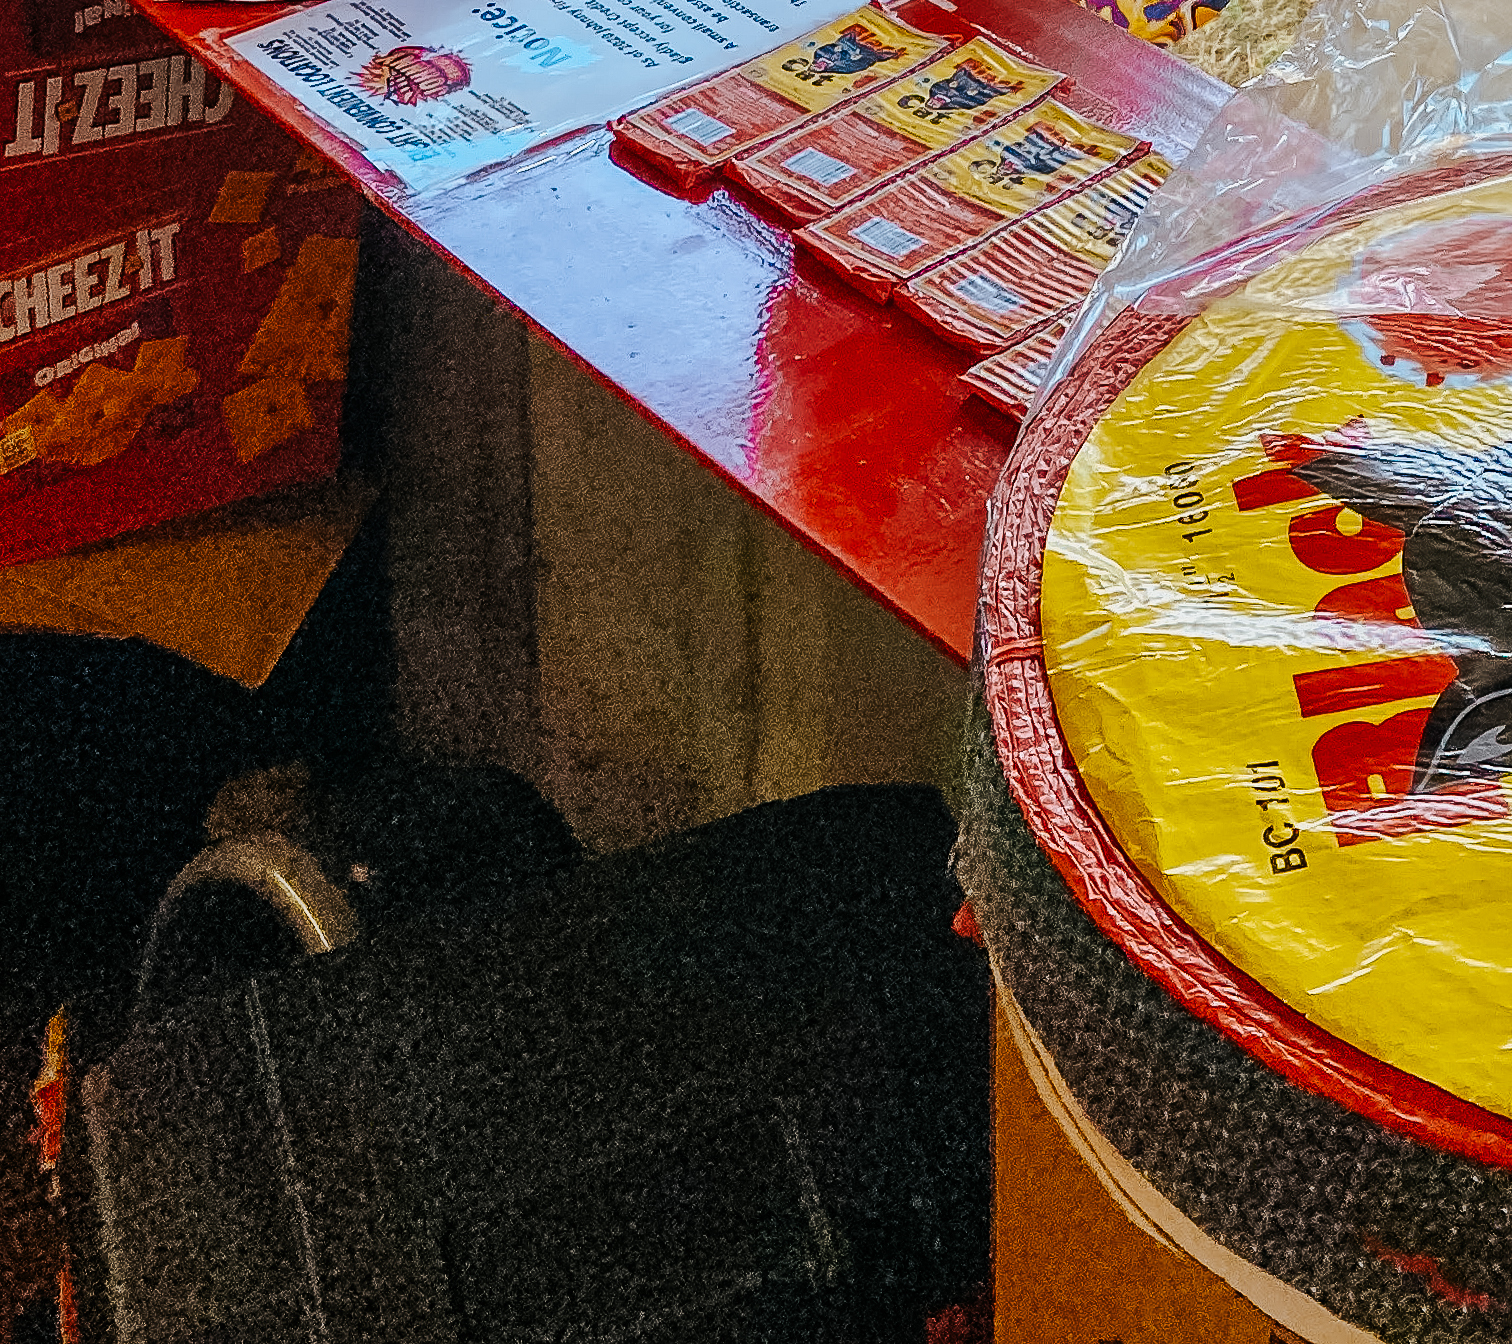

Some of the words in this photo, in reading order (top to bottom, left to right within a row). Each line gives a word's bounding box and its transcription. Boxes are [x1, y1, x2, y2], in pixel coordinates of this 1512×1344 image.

[564, 8, 610, 34] Johnny
[628, 4, 662, 22] your
[708, 12, 730, 24] be
[466, 0, 570, 67] Notice:
[616, 18, 658, 43] accept
[652, 20, 676, 34] for
[690, 22, 728, 44] small
[622, 48, 644, 58] of
[652, 40, 694, 64] gladly
[722, 40, 738, 50] A
[257, 39, 337, 88] LOCATIONS
[638, 56, 660, 68] As
[781, 57, 835, 87] Cat
[897, 94, 952, 125] Cat
[1246, 760, 1291, 808] 101
[1262, 823, 1308, 875] BC
